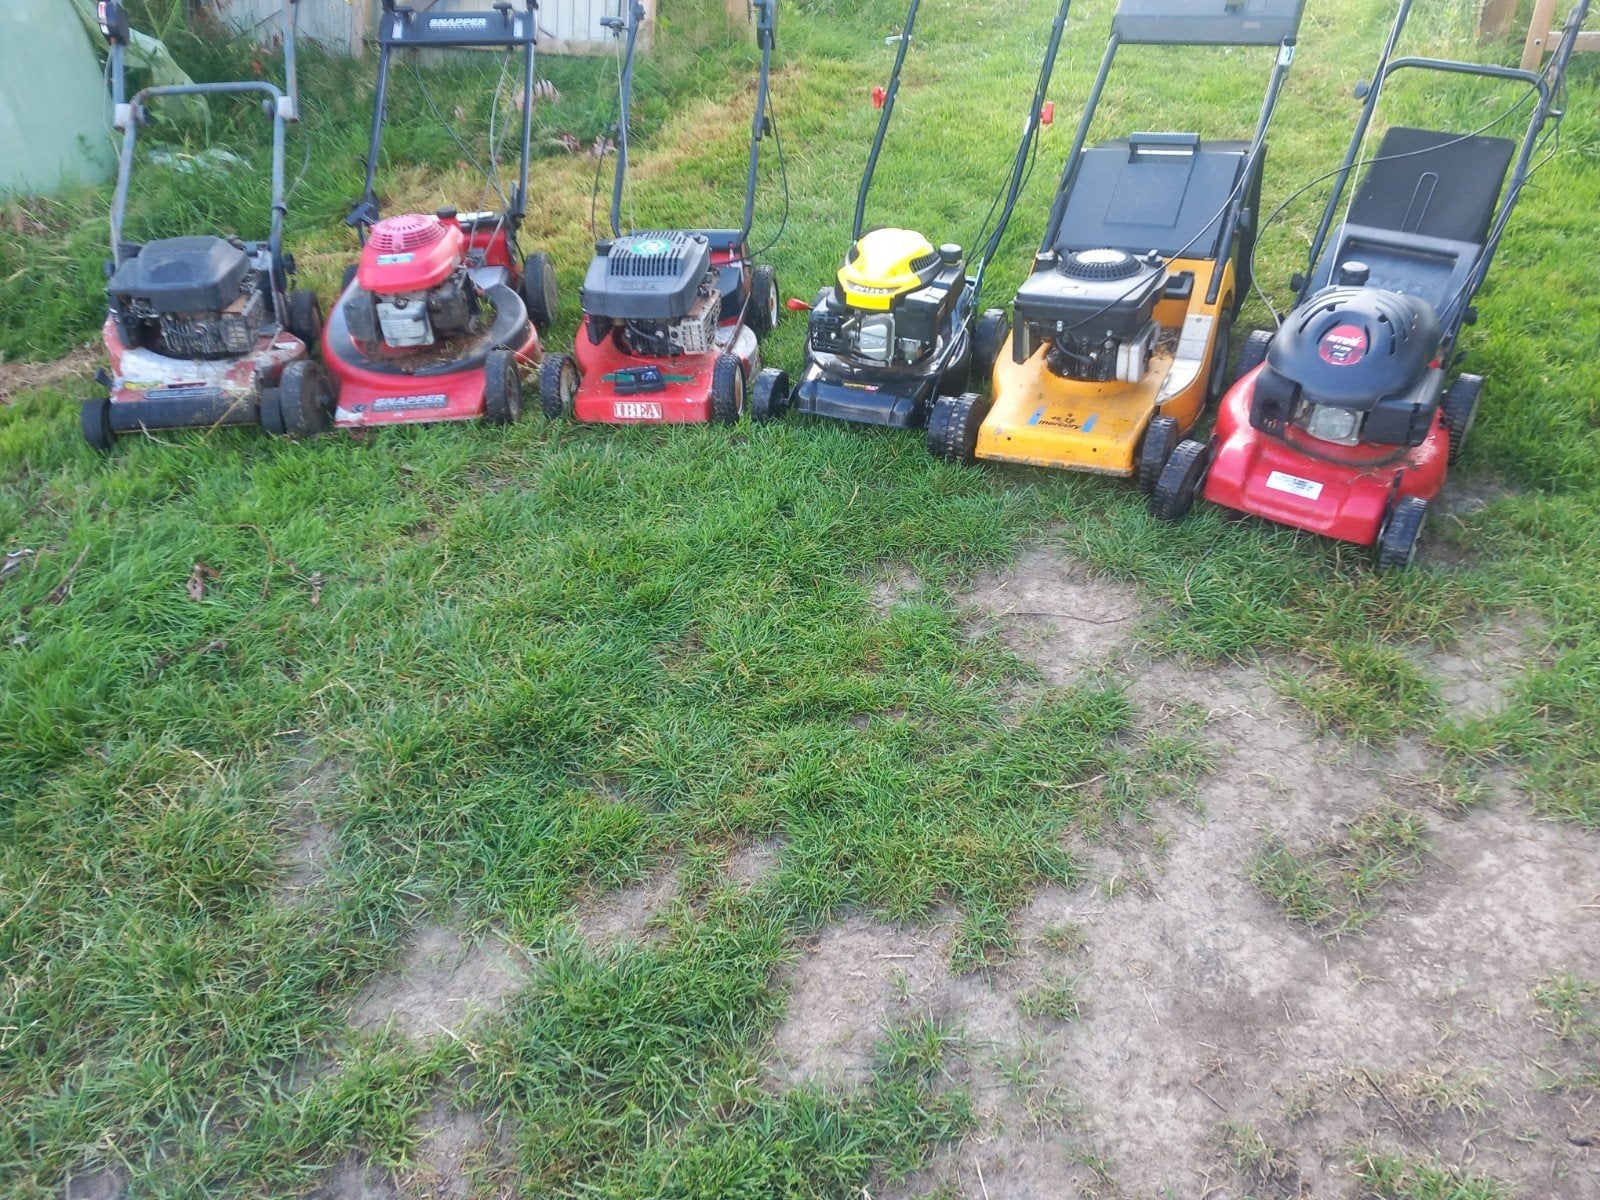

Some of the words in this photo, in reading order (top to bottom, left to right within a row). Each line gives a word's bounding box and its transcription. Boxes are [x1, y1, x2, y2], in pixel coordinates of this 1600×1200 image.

[429, 18, 487, 27] SNAPPER
[374, 394, 446, 407] SNAPPER
[615, 403, 660, 418] IBEA
[1038, 420, 1082, 430] mercury
